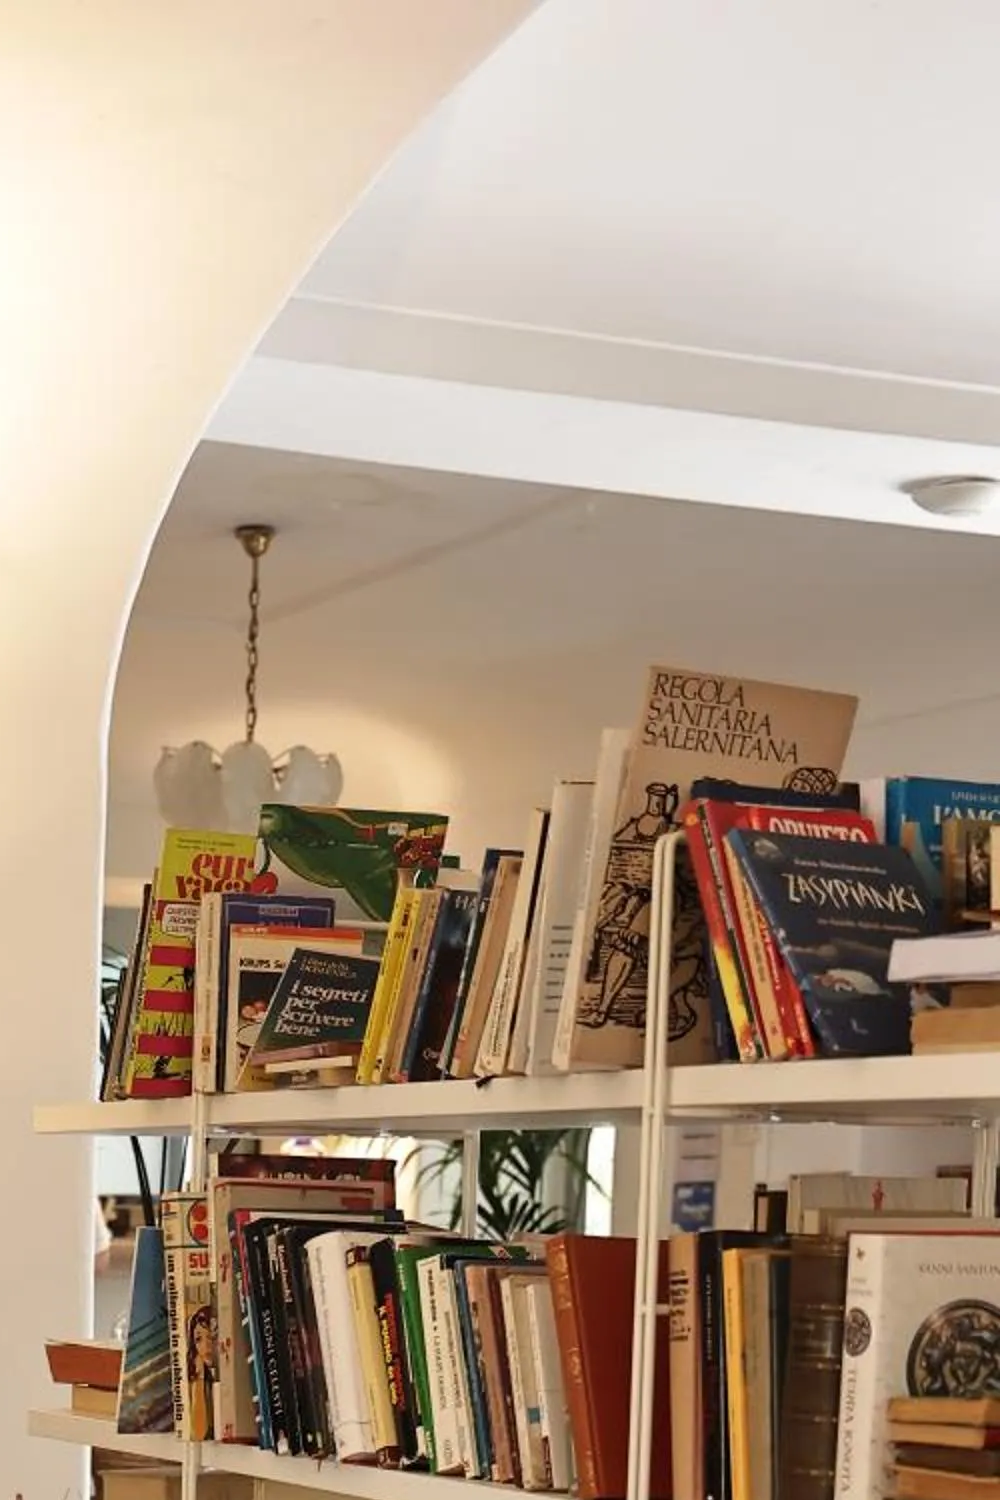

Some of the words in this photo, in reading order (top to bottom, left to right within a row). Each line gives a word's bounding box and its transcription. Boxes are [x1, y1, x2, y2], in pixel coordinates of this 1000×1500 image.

[652, 672, 745, 707] REGOLA
[647, 697, 772, 737] SANITARIA
[642, 720, 799, 765] SALERNITANA
[302, 984, 369, 1004] segreti
[283, 996, 320, 1013] per
[273, 1018, 320, 1037] bene
[279, 1008, 355, 1027] scrivere
